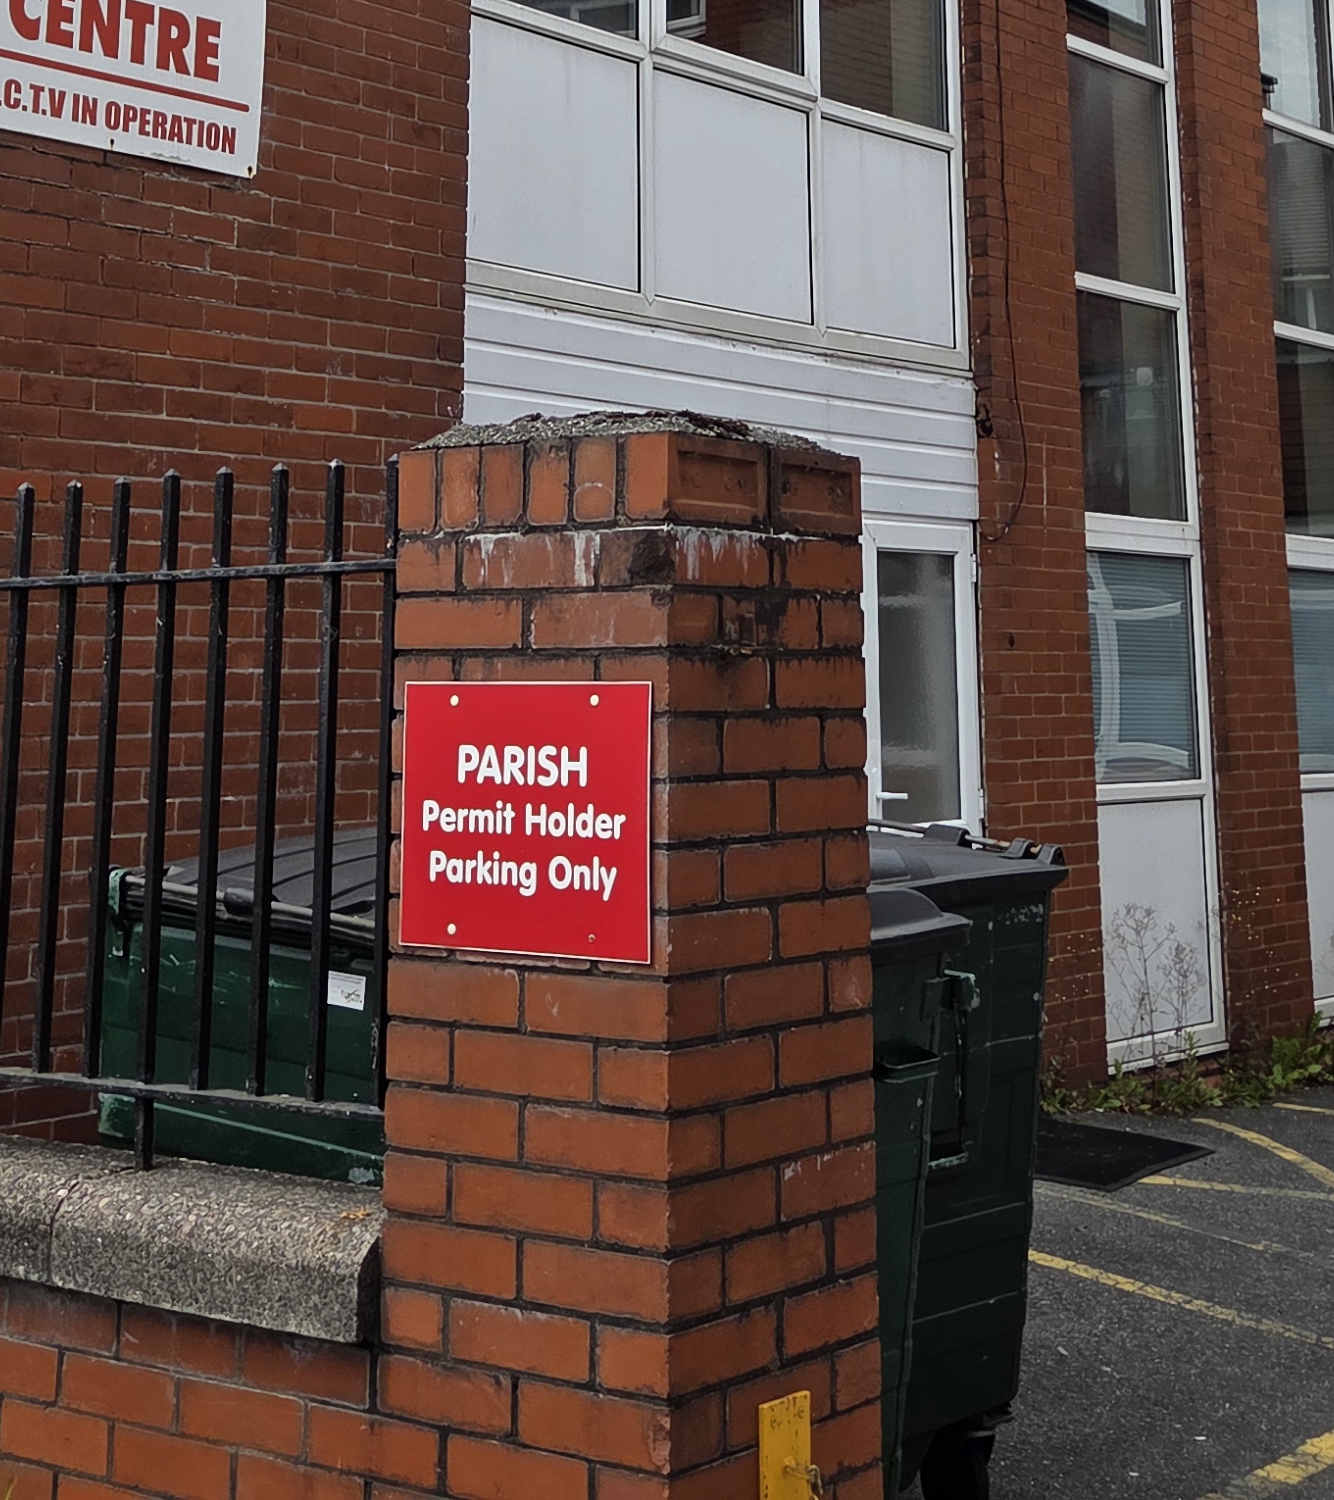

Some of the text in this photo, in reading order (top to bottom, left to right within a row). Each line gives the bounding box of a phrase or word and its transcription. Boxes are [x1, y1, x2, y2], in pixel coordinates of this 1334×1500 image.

[72, 94, 98, 126] IN
[105, 101, 237, 155] OPERATION
[457, 744, 588, 787] PARISH
[422, 799, 627, 840] Permit Holder
[429, 850, 618, 902] Parking Only
